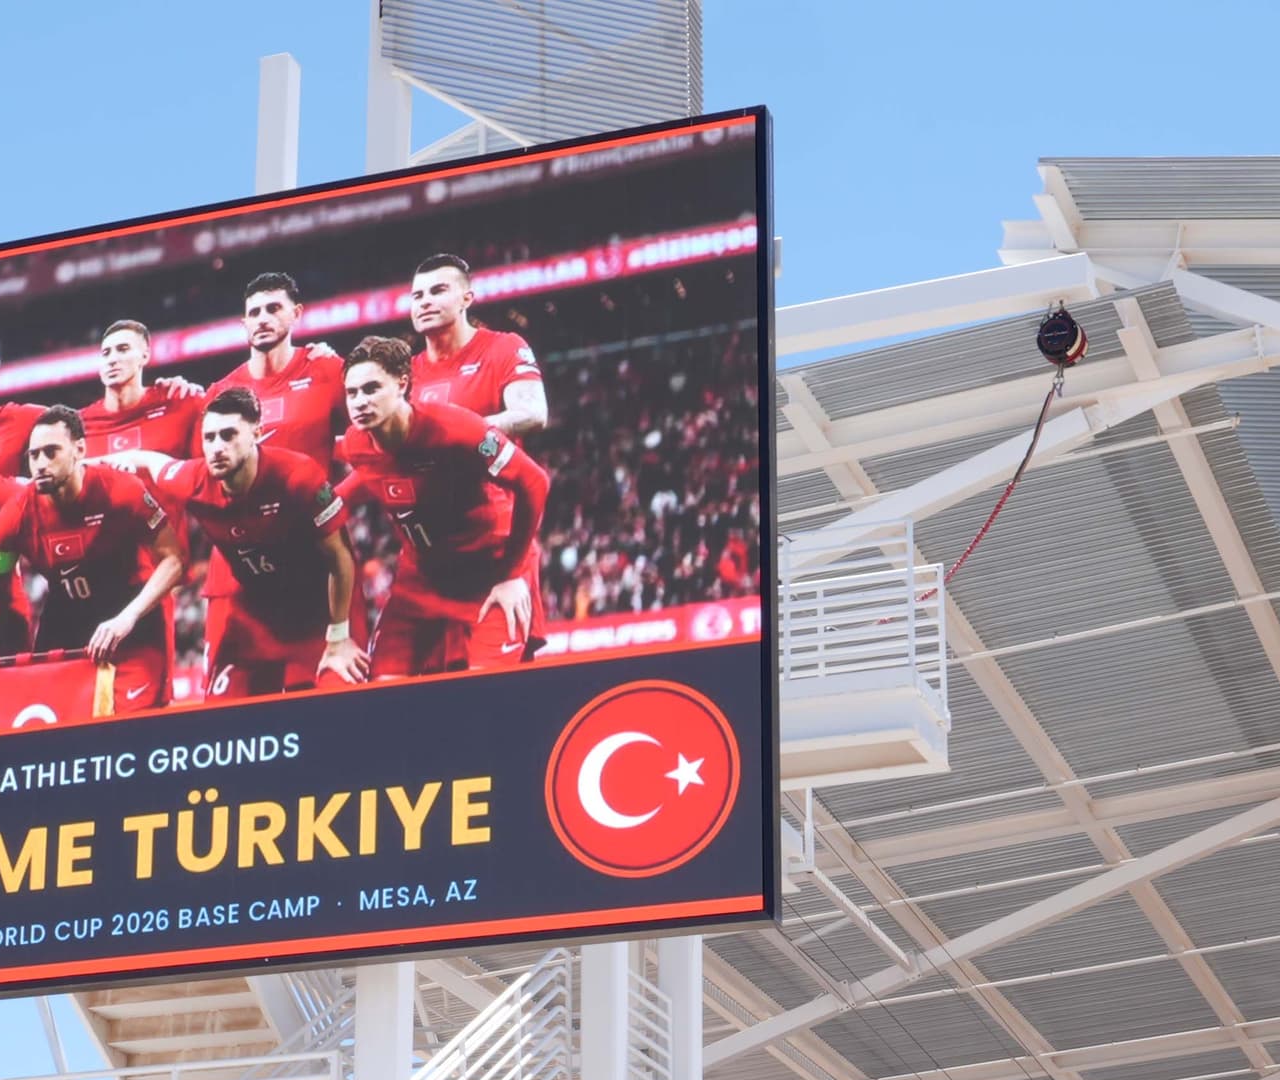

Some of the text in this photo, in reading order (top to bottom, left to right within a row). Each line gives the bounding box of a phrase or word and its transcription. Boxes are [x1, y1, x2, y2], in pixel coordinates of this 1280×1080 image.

[60, 576, 91, 600] 10
[241, 555, 275, 576] 16
[0, 753, 136, 795] ATHLETIC
[148, 732, 301, 775] GROUNDS
[122, 776, 493, 880] TÜRKIYE
[54, 917, 100, 943] CUP
[111, 908, 170, 937] 2026
[178, 902, 240, 930] BASE
[248, 896, 321, 923] CAMP
[359, 884, 436, 911] MESA,
[445, 879, 478, 903] AZ
